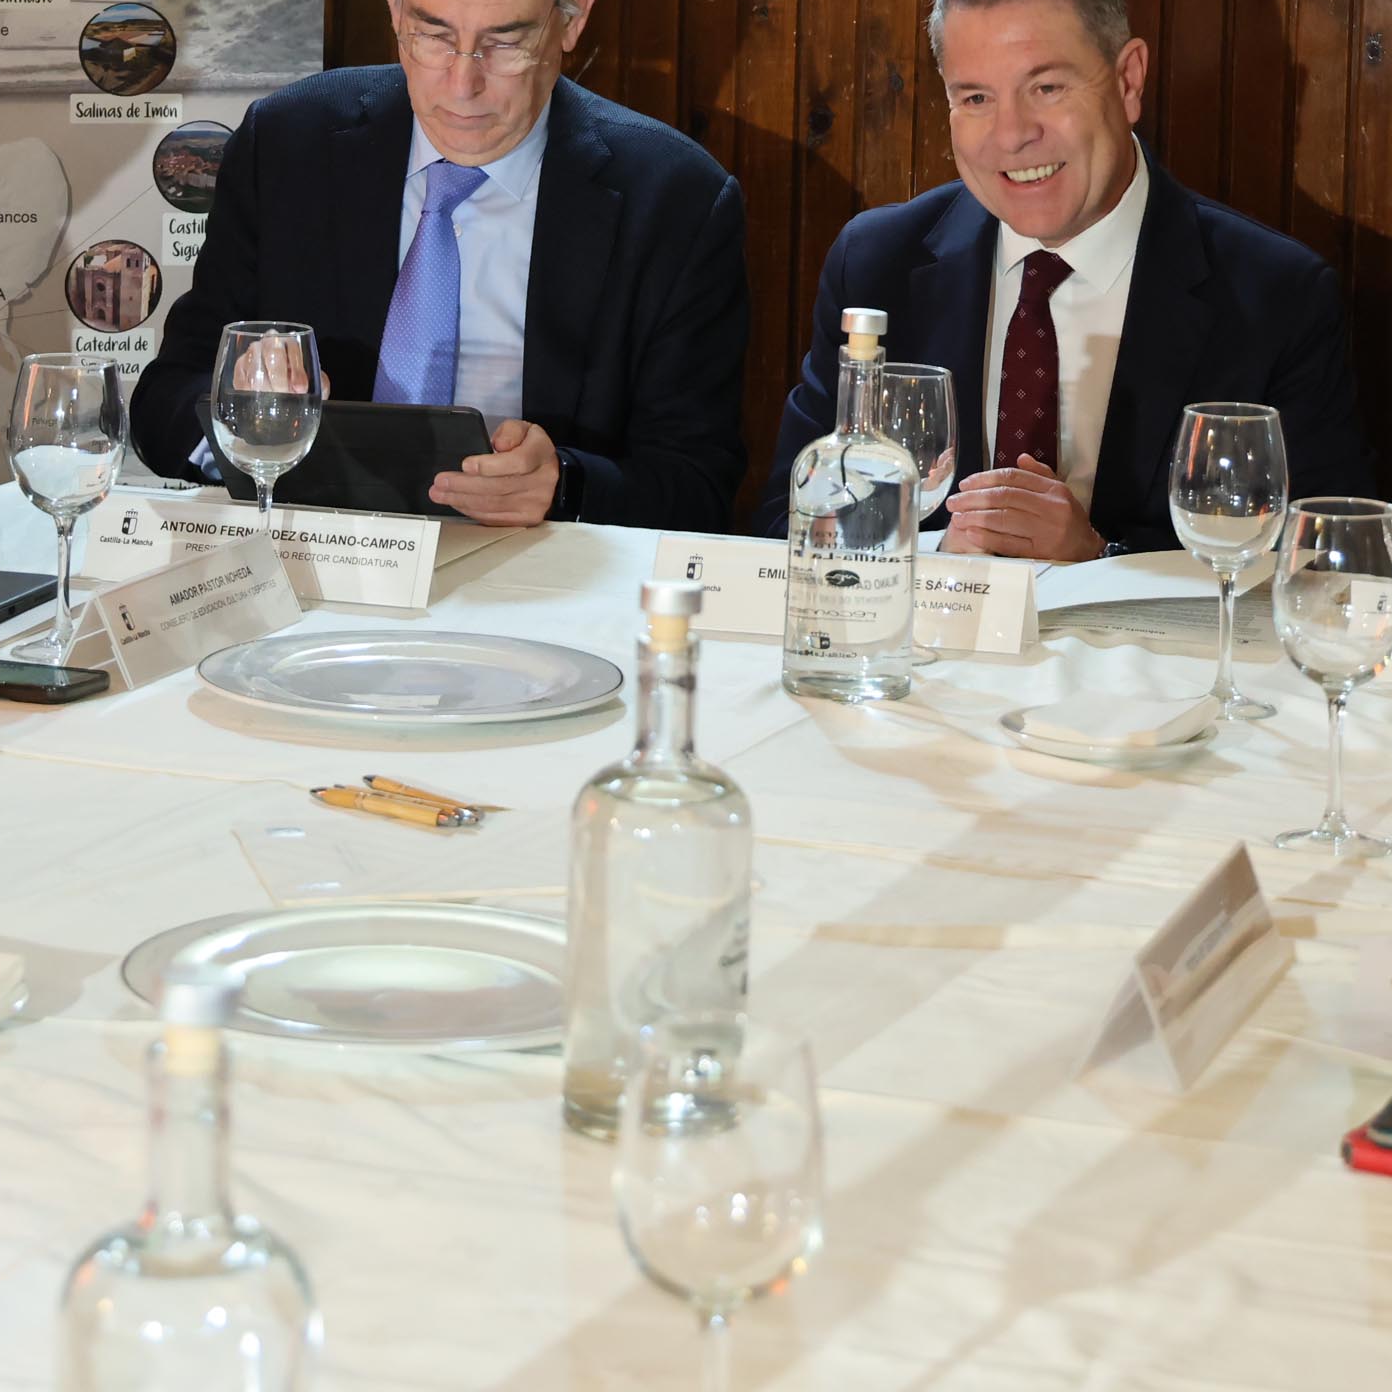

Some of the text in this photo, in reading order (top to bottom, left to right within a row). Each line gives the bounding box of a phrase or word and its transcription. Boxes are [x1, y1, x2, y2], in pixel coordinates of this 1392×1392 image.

[76, 101, 177, 119] Salinas de Imón
[76, 335, 149, 352] Catedral de
[132, 538, 154, 547] Mancha
[160, 520, 416, 551] ANTONIO FERNDEZ GALIANO-CAMPOS
[292, 552, 330, 563] RECTOR
[332, 555, 399, 568] CANDIDATURA
[169, 566, 253, 606] AMADOR PASTOR NOHEDA
[925, 577, 991, 595] SÁNCHEZ
[930, 600, 973, 612] MANCHA
